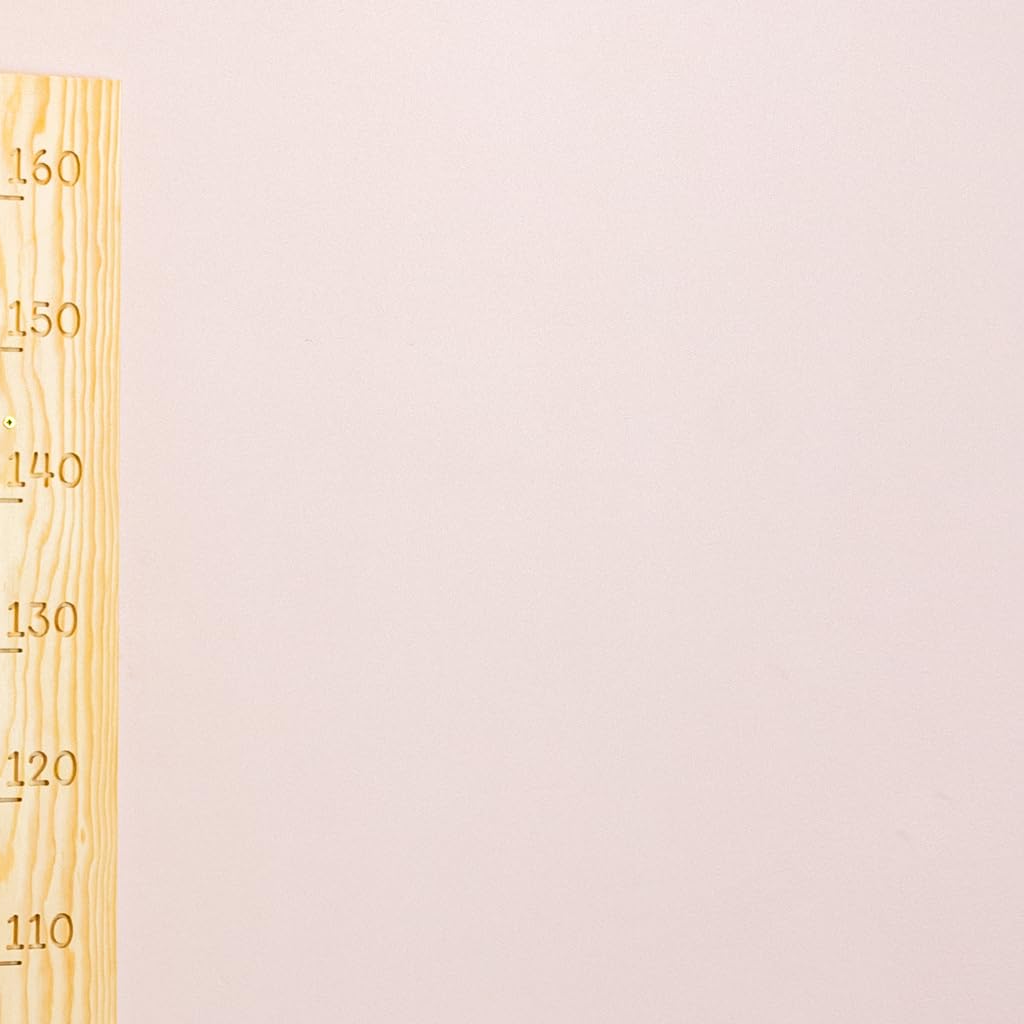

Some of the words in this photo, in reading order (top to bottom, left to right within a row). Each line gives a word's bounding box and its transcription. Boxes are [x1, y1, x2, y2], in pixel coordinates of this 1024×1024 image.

[9, 147, 81, 185] 160
[9, 300, 81, 337] 150
[9, 451, 83, 488] 140
[7, 601, 78, 638] 130
[7, 750, 78, 787] 120
[6, 912, 74, 949] 110
